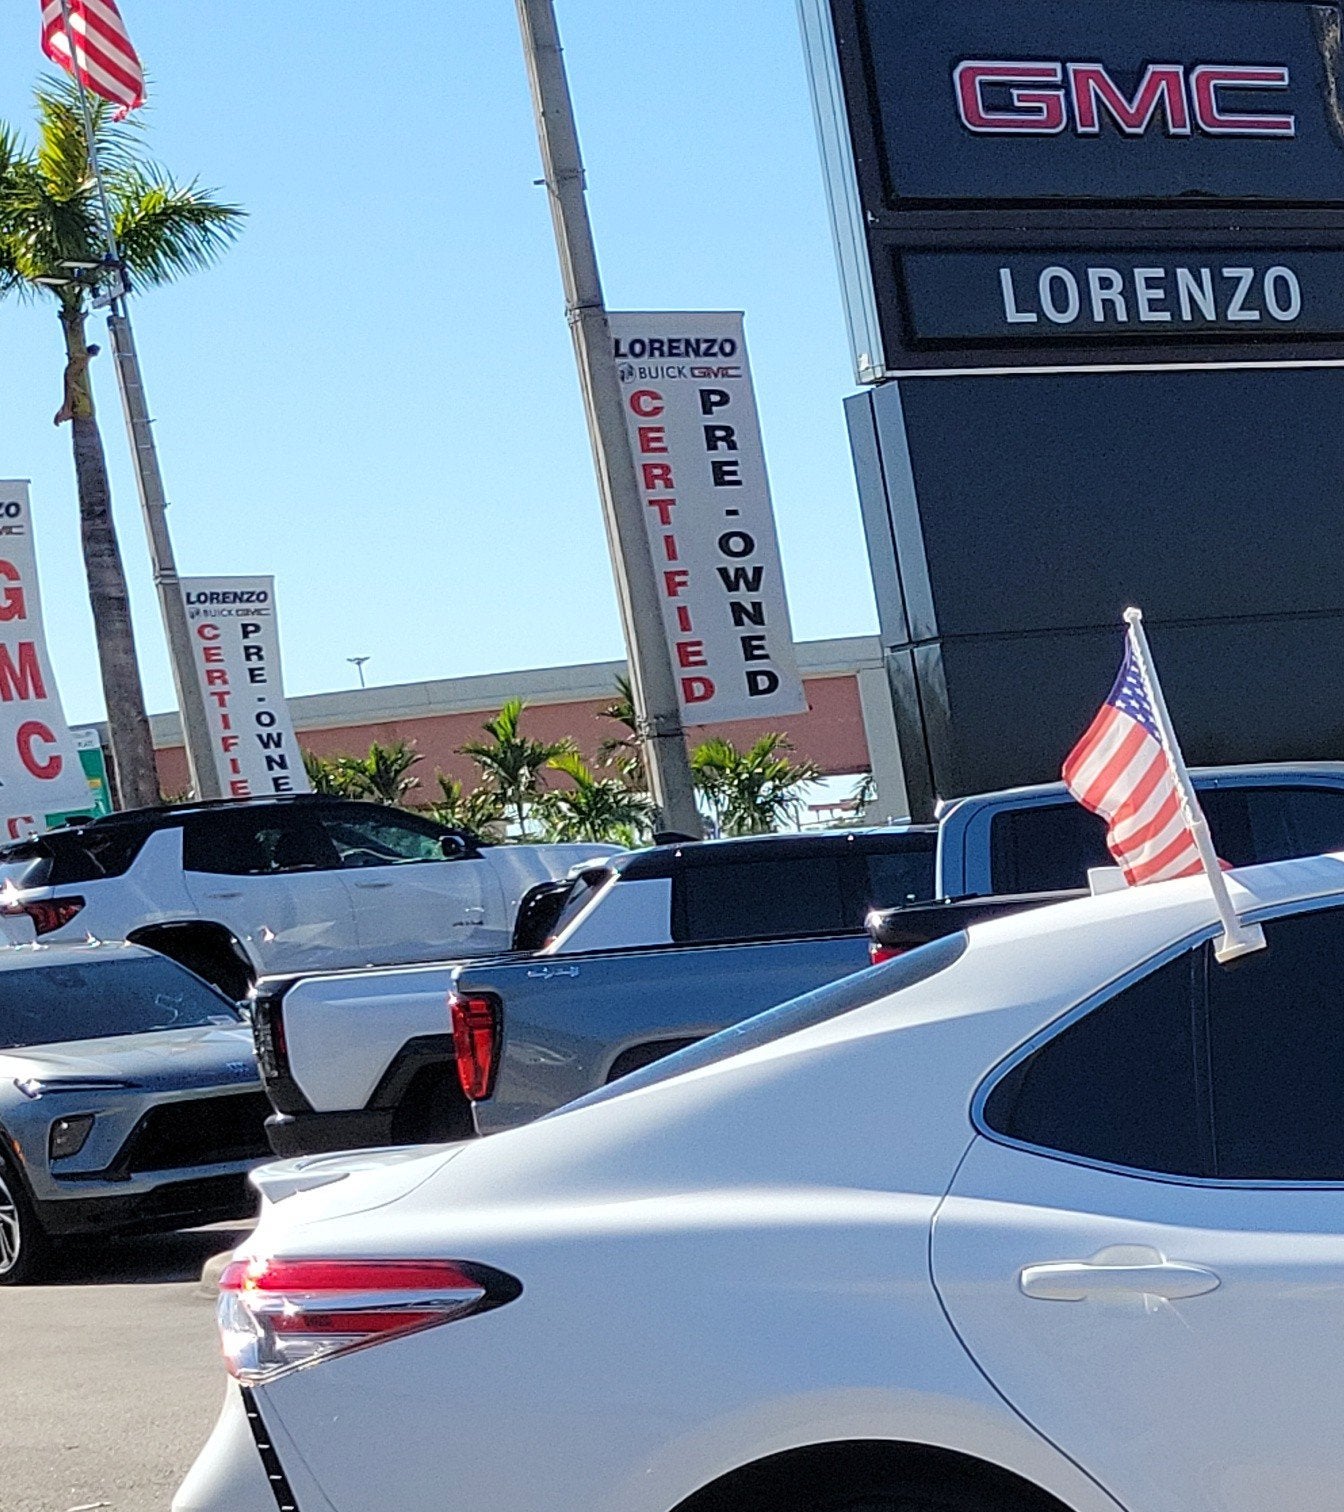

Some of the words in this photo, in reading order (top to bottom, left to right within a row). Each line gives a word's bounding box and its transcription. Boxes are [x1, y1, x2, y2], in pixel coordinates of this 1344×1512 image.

[953, 60, 1296, 136] GMC
[999, 265, 1302, 324] LORENZO
[613, 337, 738, 360] LORENZO
[638, 365, 689, 380] BUICK
[690, 365, 743, 379] GMC
[628, 388, 716, 705] CERTIFIED
[698, 387, 780, 698] PRE-OWNED
[185, 590, 269, 606] LORENZO
[202, 609, 234, 619] BUICK
